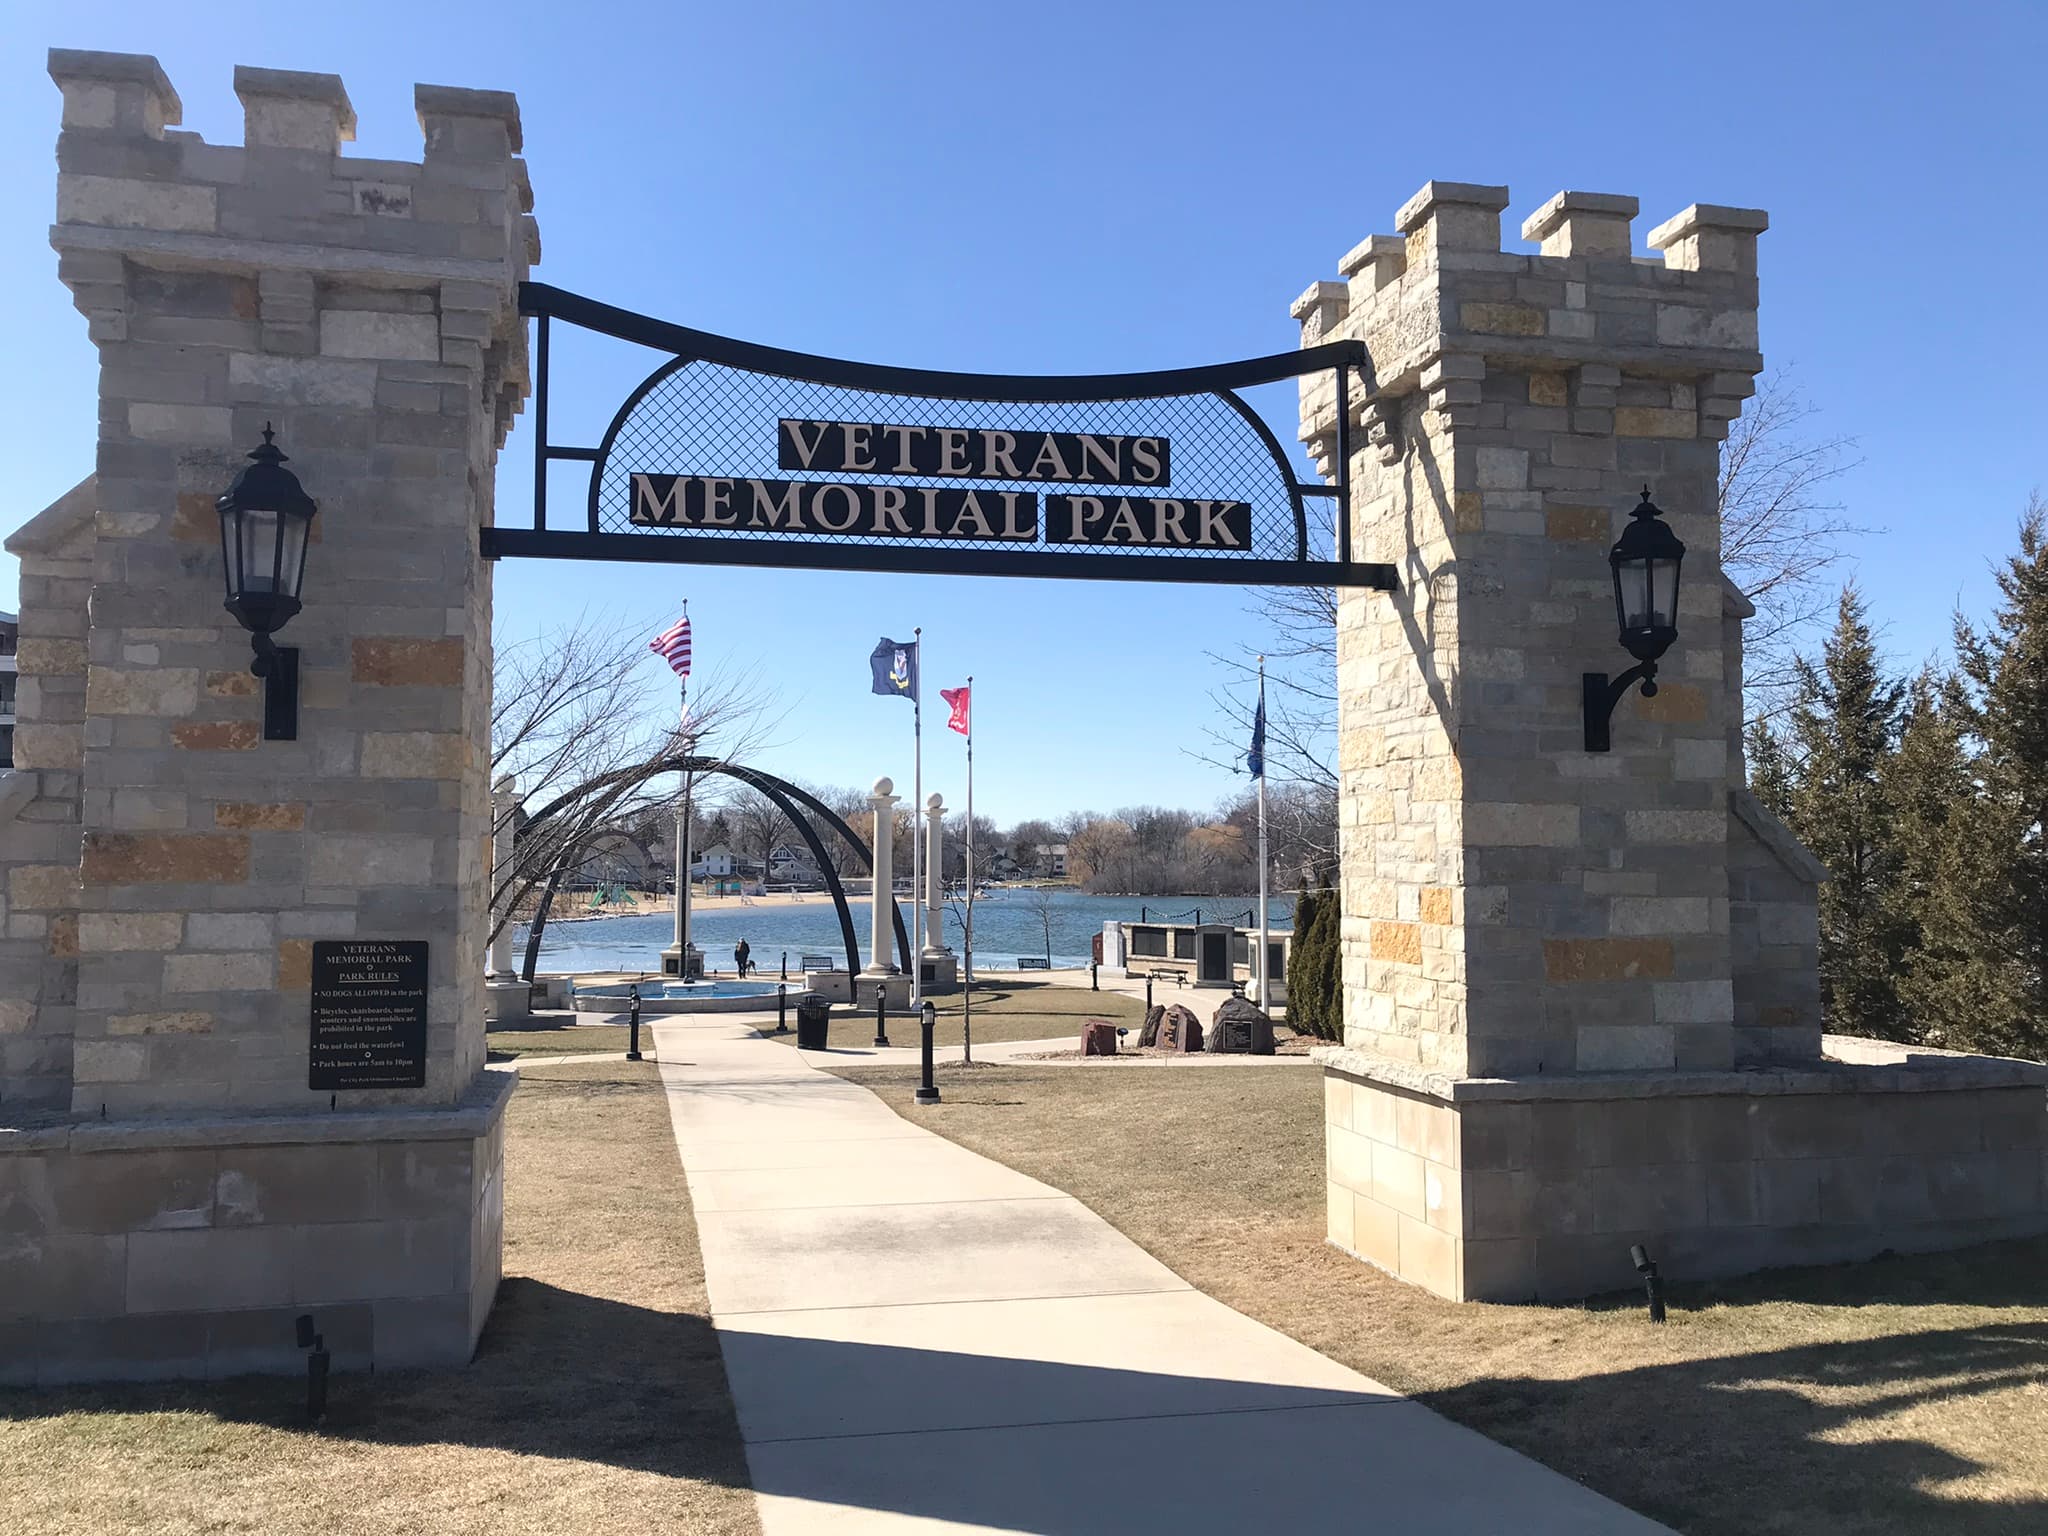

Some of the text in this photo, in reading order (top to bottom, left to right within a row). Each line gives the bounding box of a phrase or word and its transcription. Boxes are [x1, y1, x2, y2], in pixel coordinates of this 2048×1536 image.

[781, 419, 1161, 484] VETERANS
[631, 473, 1240, 546] MEMORIAL PARK
[343, 945, 396, 953] VETERANS
[326, 955, 412, 964] MEMORIAL PARK
[339, 972, 400, 980] PARK RULES
[354, 989, 390, 997] ALLOWED
[408, 989, 423, 998] park
[319, 1025, 355, 1034] prohibited
[364, 1024, 376, 1032] the
[376, 1024, 393, 1033] park
[319, 1060, 336, 1068] Park
